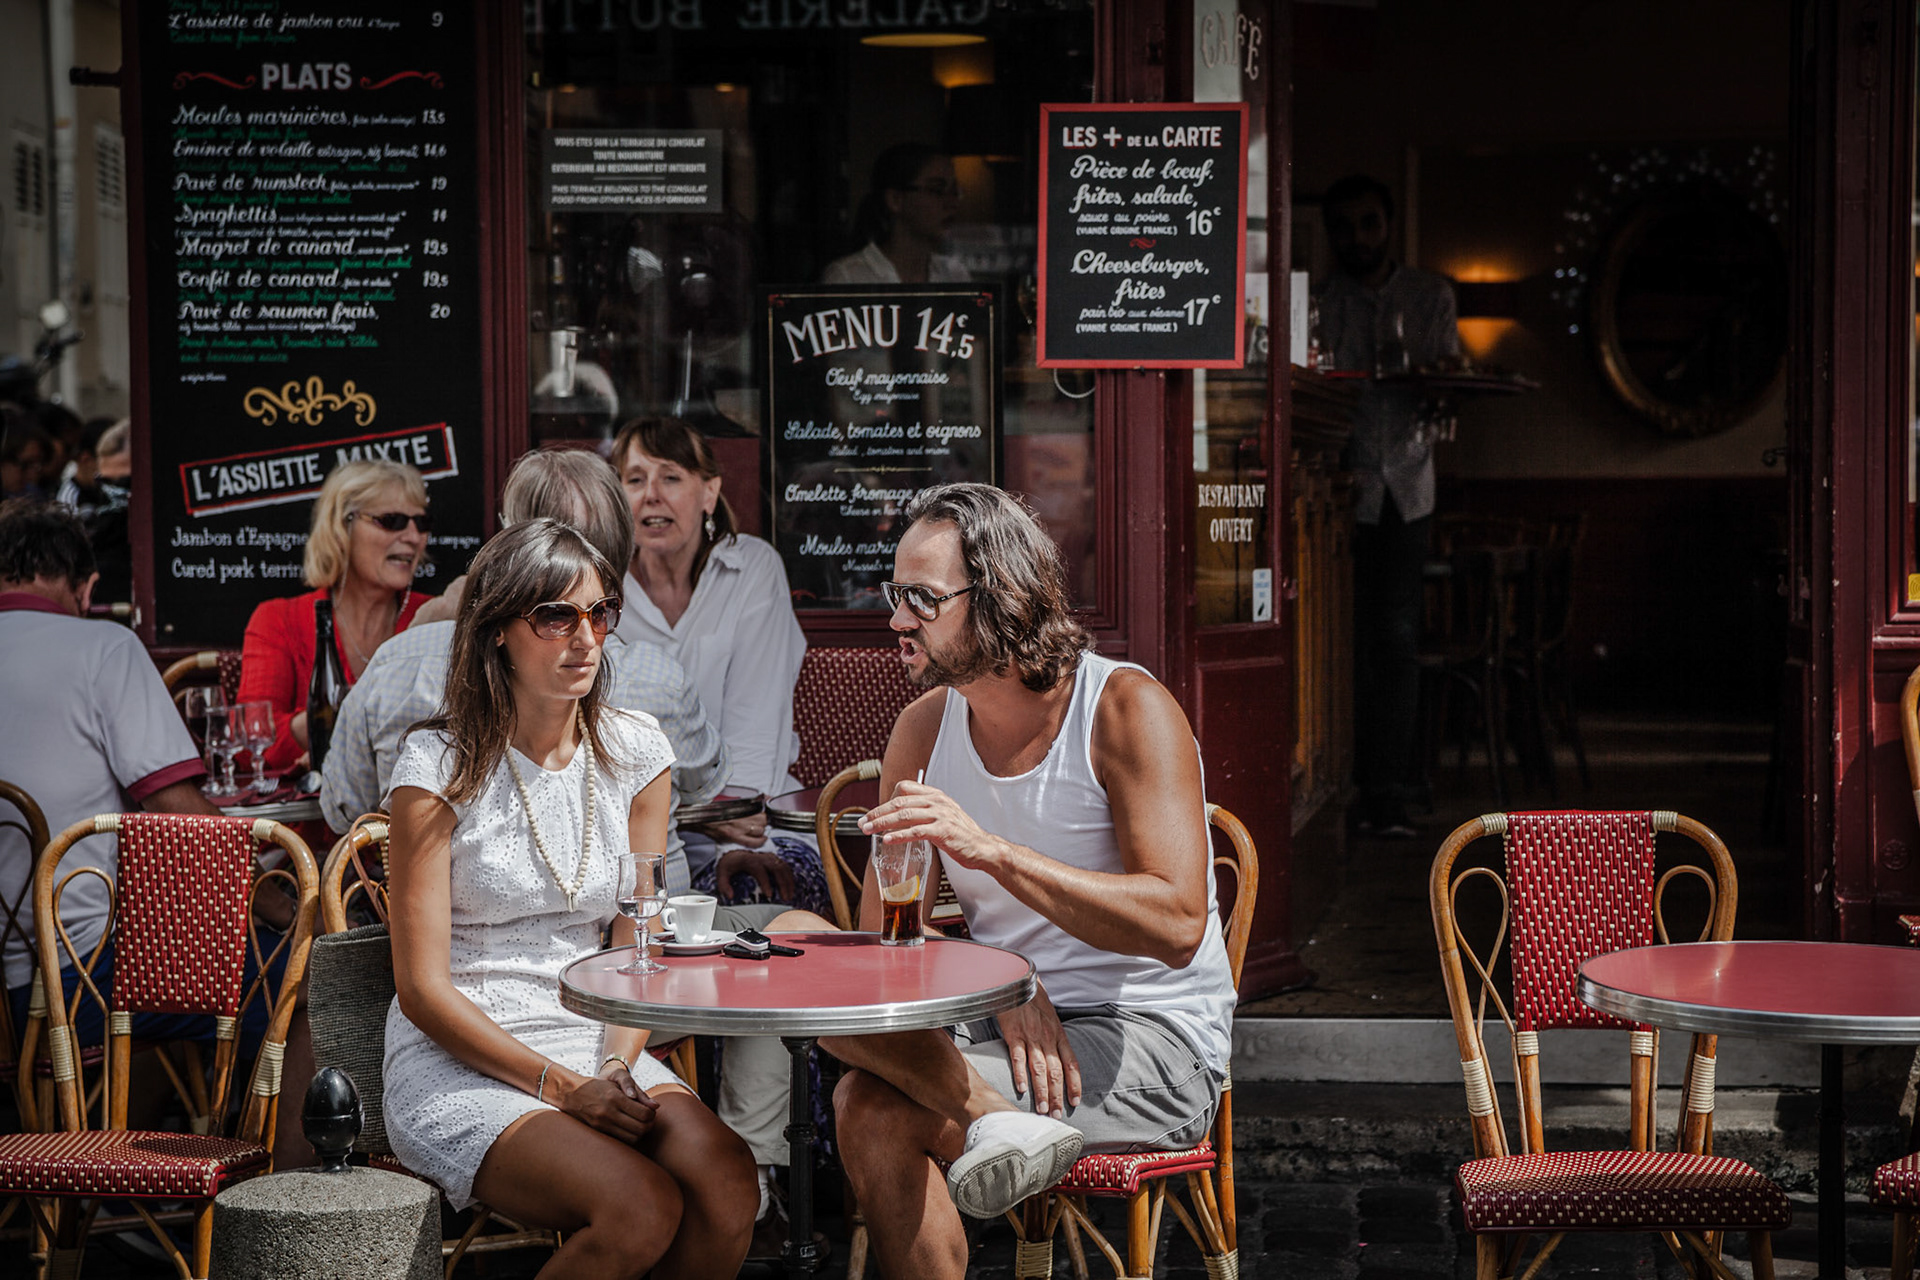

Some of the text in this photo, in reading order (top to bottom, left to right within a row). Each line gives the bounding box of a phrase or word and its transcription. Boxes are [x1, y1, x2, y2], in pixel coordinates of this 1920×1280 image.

[252, 11, 274, 29] de
[278, 11, 332, 33] jambon
[336, 17, 363, 29] cru
[431, 10, 444, 28] 9
[261, 62, 352, 91] PLATS
[171, 102, 242, 126] Moules
[236, 140, 258, 157] de
[259, 140, 315, 158] volaille
[1063, 126, 1098, 148] LES
[1127, 135, 1142, 148] DE
[1145, 135, 1159, 148] LA
[1162, 126, 1222, 148] CARTE
[1070, 154, 1128, 179] Pièce
[1132, 158, 1156, 179] de
[172, 171, 217, 192] Pavé
[222, 172, 245, 191] de
[431, 175, 448, 191] 19
[1131, 184, 1199, 208] salade,
[1077, 209, 1171, 226] sauce au poivre
[176, 236, 250, 261] Magret
[256, 237, 282, 256] de
[1070, 249, 1210, 280] Cheeseburger,
[176, 268, 231, 294] Confit
[236, 268, 263, 288] de
[422, 269, 449, 288] 19,5
[1111, 278, 1166, 307] frites
[178, 300, 380, 324] Pavé de saumon frais,
[430, 302, 451, 319] 20
[1079, 304, 1107, 320] pain
[1107, 304, 1126, 319] bio
[781, 304, 902, 364] MENU
[864, 368, 950, 391] mayonnaise
[784, 419, 982, 446] Salade, tomates et oignons
[191, 453, 324, 502] L'ASSIETTE
[784, 482, 914, 507] Omelette fromage
[1198, 484, 1266, 508] RESTAURANT
[171, 526, 232, 546] Jambon
[1210, 518, 1254, 542] OUVERT
[799, 534, 853, 556] Moules
[172, 557, 216, 578] Cured
[220, 556, 255, 584] pork
